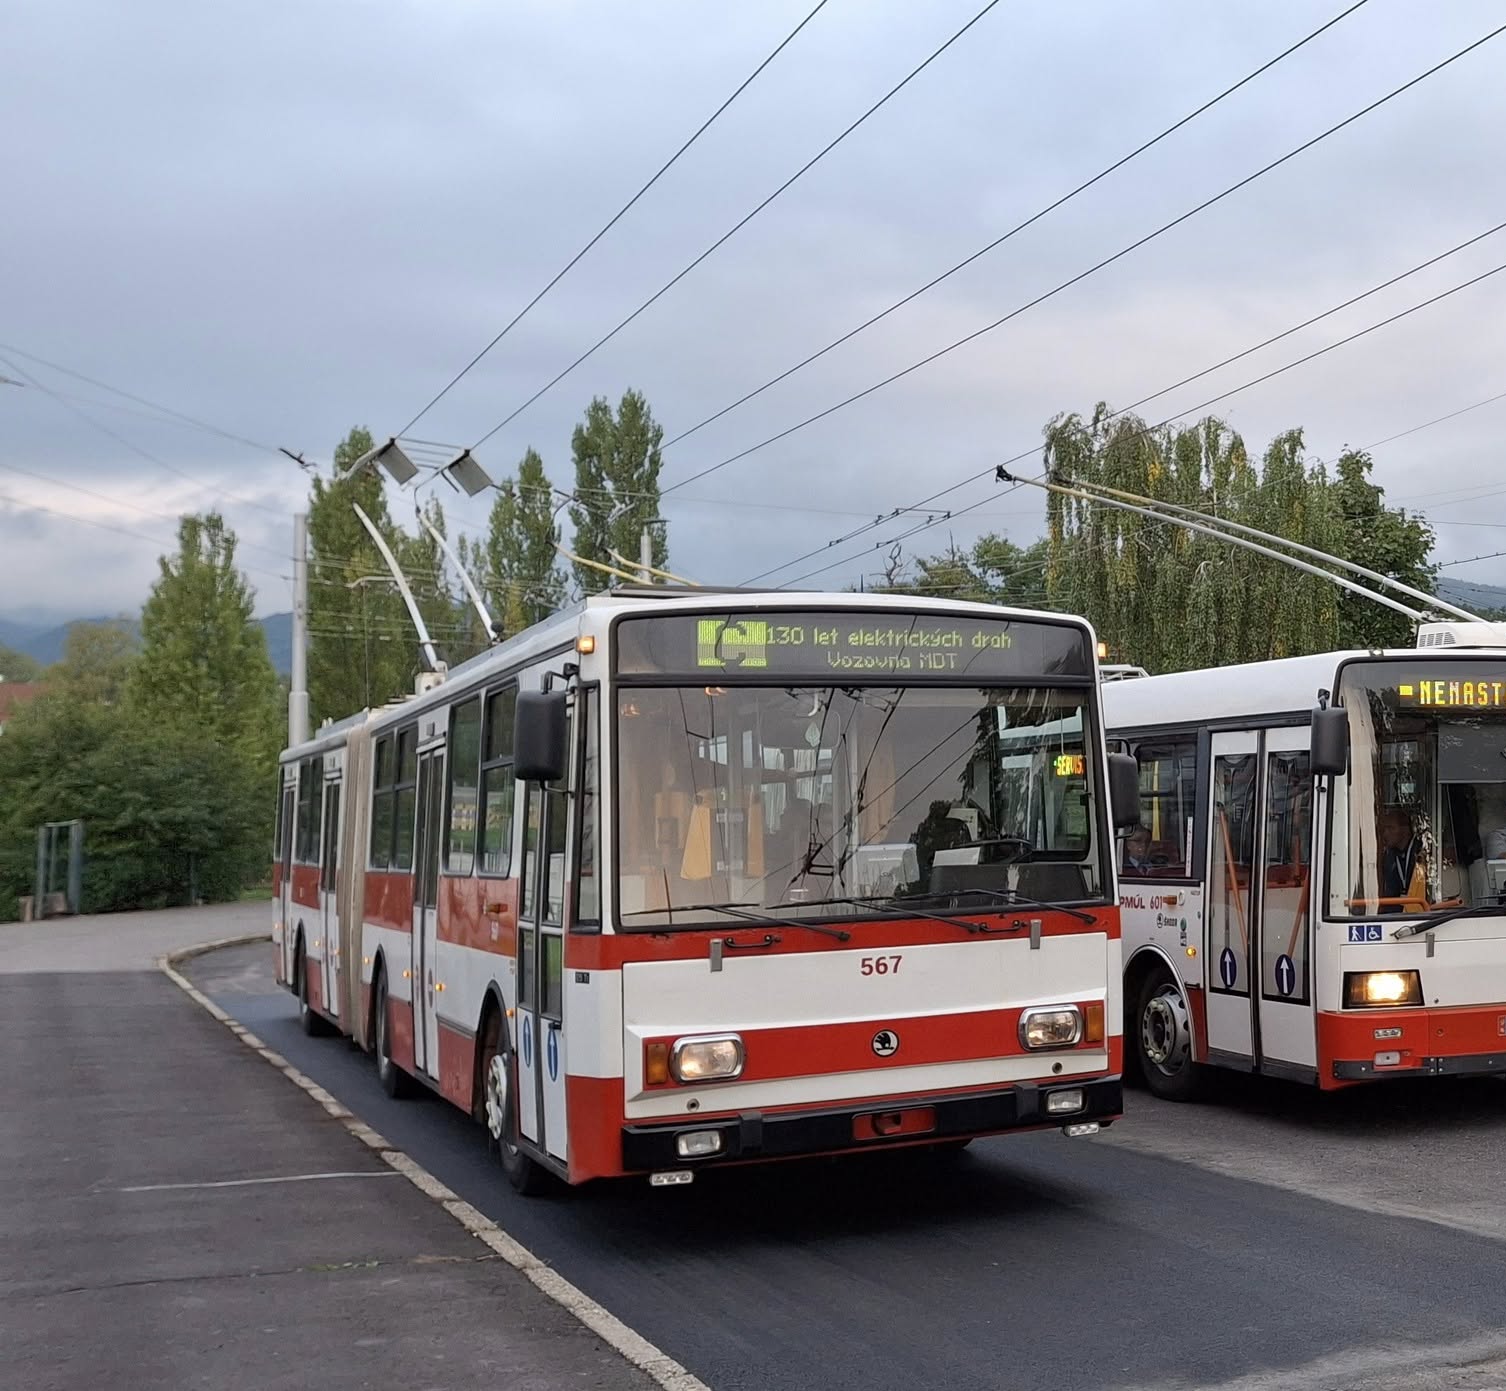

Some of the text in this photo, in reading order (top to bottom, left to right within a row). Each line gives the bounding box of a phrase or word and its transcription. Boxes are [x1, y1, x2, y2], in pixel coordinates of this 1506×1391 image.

[767, 626, 1012, 649] 130 let elektrických drah
[827, 651, 958, 669] Vozovna MDT
[1119, 893, 1163, 909] PMÚL 601
[861, 955, 903, 976] 567
